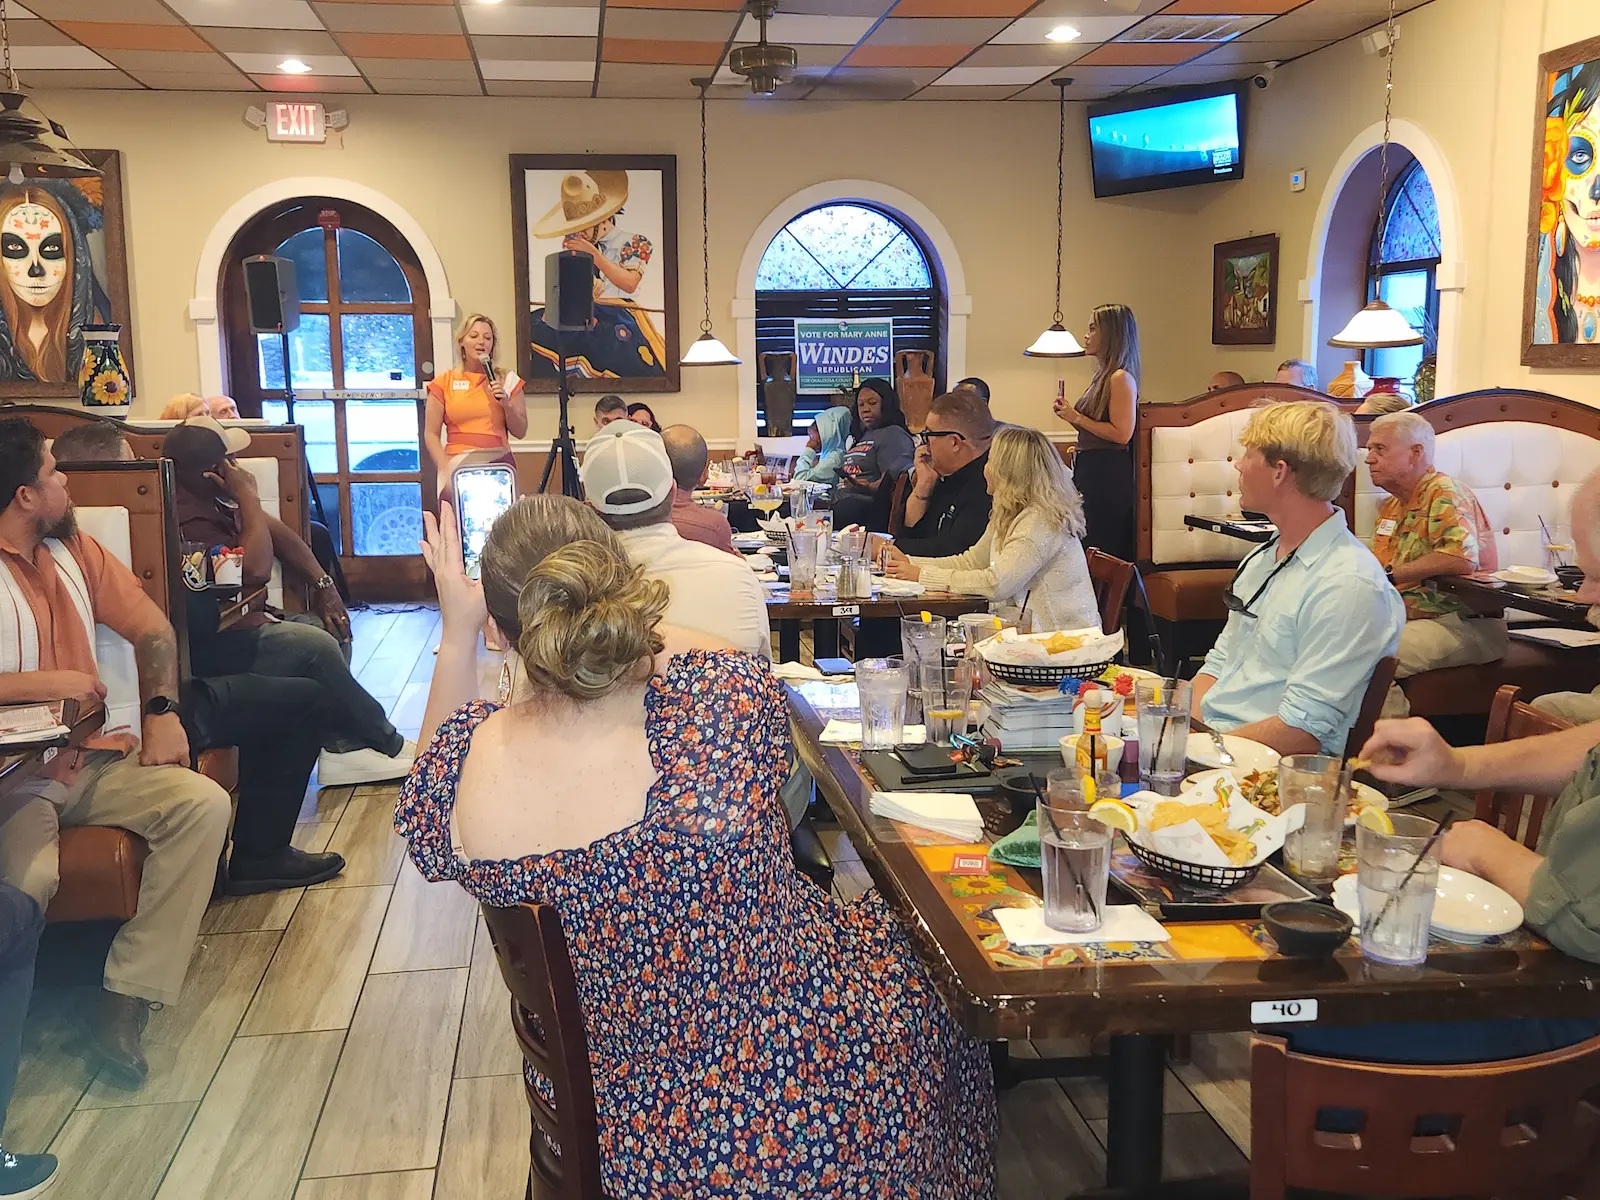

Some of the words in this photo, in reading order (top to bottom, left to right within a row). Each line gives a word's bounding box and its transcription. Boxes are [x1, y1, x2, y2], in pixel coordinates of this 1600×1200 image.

[275, 104, 316, 135] EXIT
[864, 330, 888, 338] ANNE
[799, 342, 889, 364] WINDES
[1272, 1002, 1301, 1016] 40
